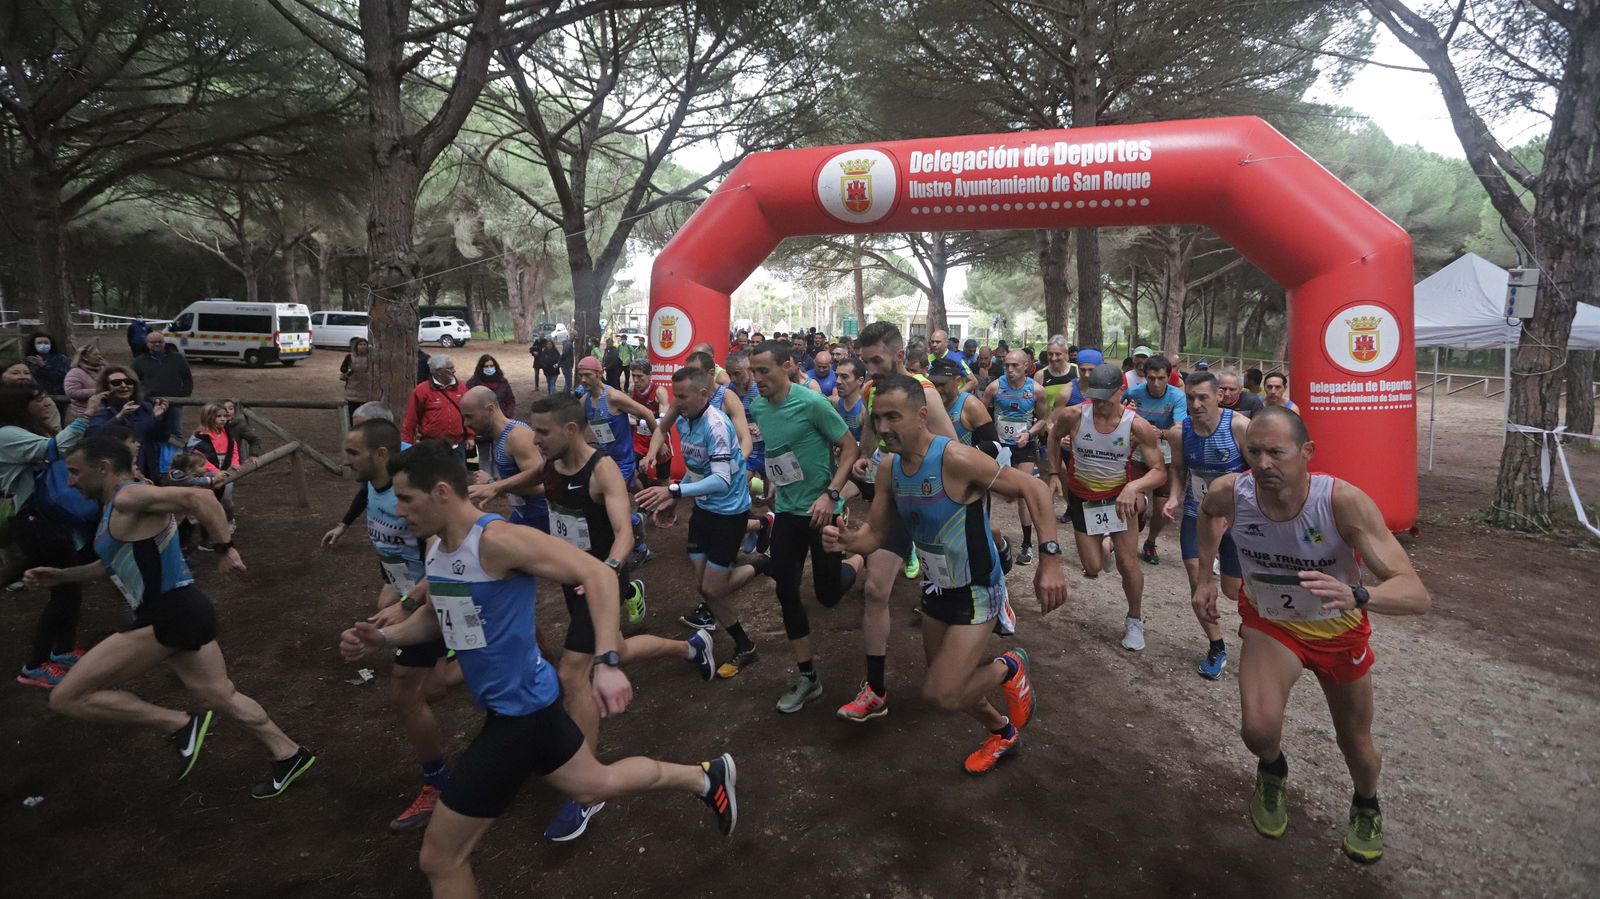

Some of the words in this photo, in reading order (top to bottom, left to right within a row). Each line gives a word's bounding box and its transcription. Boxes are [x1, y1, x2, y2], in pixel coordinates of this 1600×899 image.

[909, 145, 1020, 174] Delegación
[1023, 143, 1050, 167] de
[1053, 139, 1152, 167] Deportes
[909, 180, 952, 198] Ilustre
[955, 175, 1049, 198] Ayuntamiento
[1052, 173, 1070, 192] de
[1073, 171, 1100, 191] San
[1103, 170, 1151, 190] Roque
[1310, 381, 1363, 394] Delegación
[1365, 381, 1378, 392] de
[1379, 380, 1412, 392] Deportes
[1310, 396, 1330, 404] Ilustre
[1331, 395, 1379, 404] Ayuntamiento
[1380, 394, 1387, 402] de
[1004, 425, 1015, 435] 93
[1076, 447, 1094, 455] CLUB
[768, 464, 783, 477] 70
[1095, 512, 1109, 525] 34
[556, 519, 568, 537] 99
[1240, 548, 1271, 561] CLUB
[1273, 554, 1337, 568] TRIATLÓN
[1280, 594, 1295, 609] 2
[436, 608, 453, 631] 74
